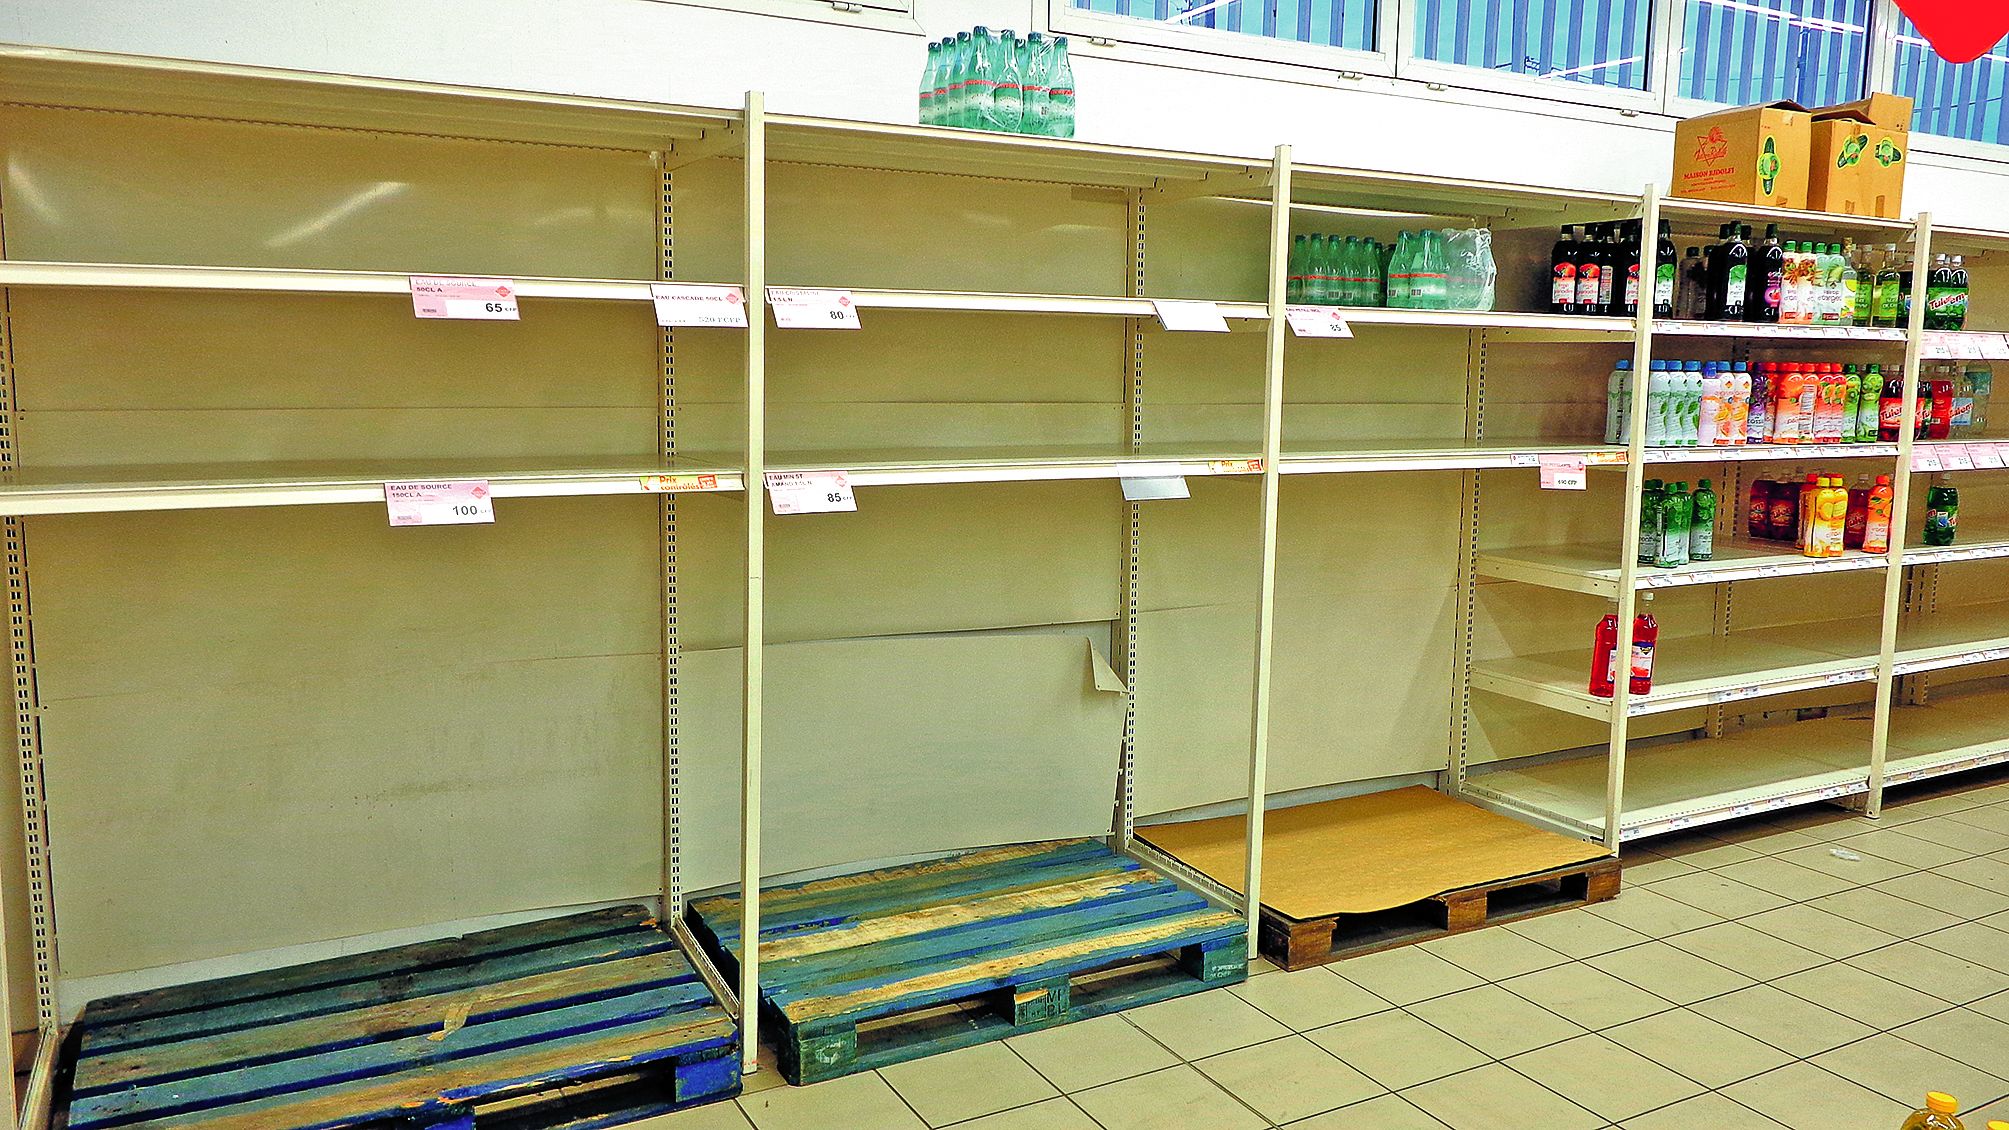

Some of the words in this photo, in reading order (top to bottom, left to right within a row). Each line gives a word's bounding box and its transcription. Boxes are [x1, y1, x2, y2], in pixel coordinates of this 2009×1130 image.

[485, 302, 503, 313] 65
[829, 310, 844, 320] 80
[827, 492, 842, 503] 85
[452, 505, 478, 516] 100
